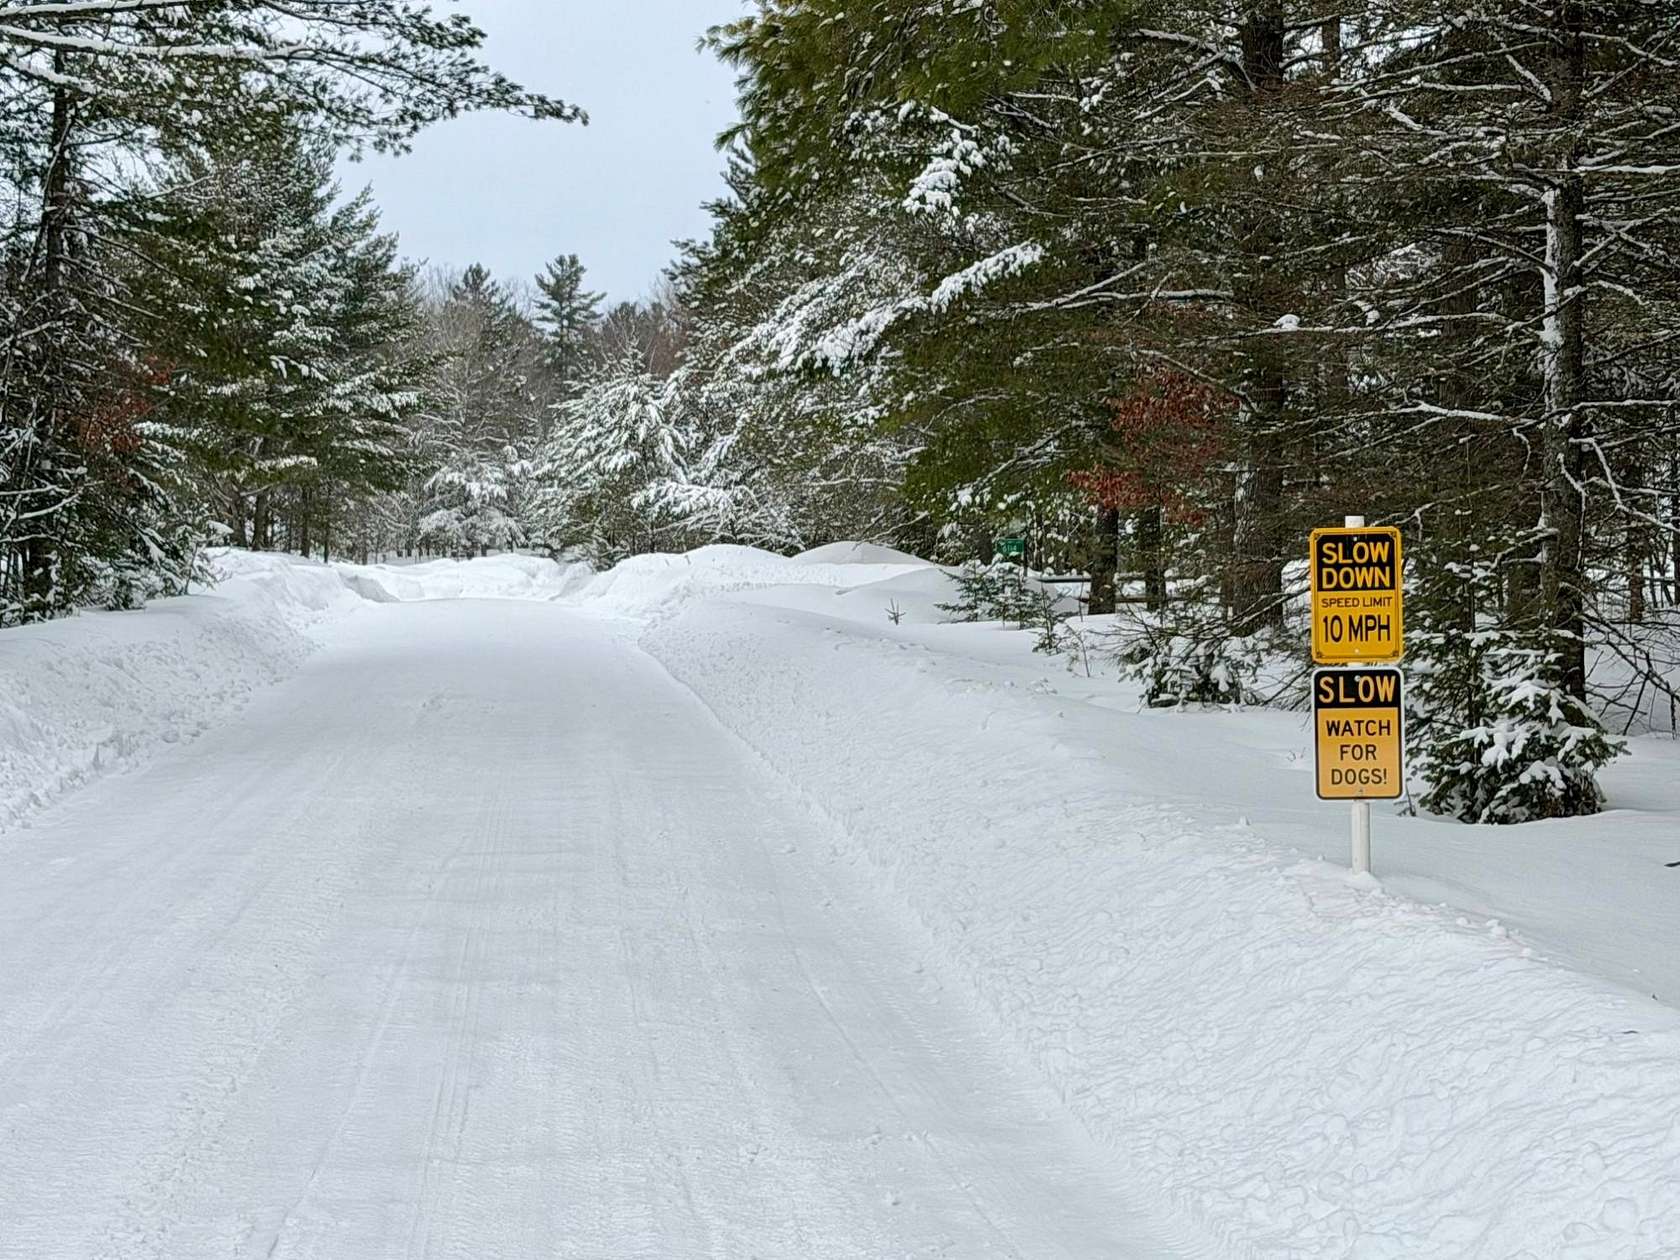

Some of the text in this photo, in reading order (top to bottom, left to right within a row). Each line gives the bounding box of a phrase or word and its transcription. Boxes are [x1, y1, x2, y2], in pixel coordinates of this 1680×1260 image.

[1322, 542, 1390, 564] SLOW
[1322, 566, 1391, 589] DOWN
[1321, 596, 1393, 608] SPEED LIMIT
[1322, 614, 1391, 643] 10 MPH
[1318, 675, 1396, 703] SLOW
[1326, 719, 1391, 737] WATCH
[1340, 744, 1377, 761] FOR
[1331, 768, 1387, 785] DOGS!
